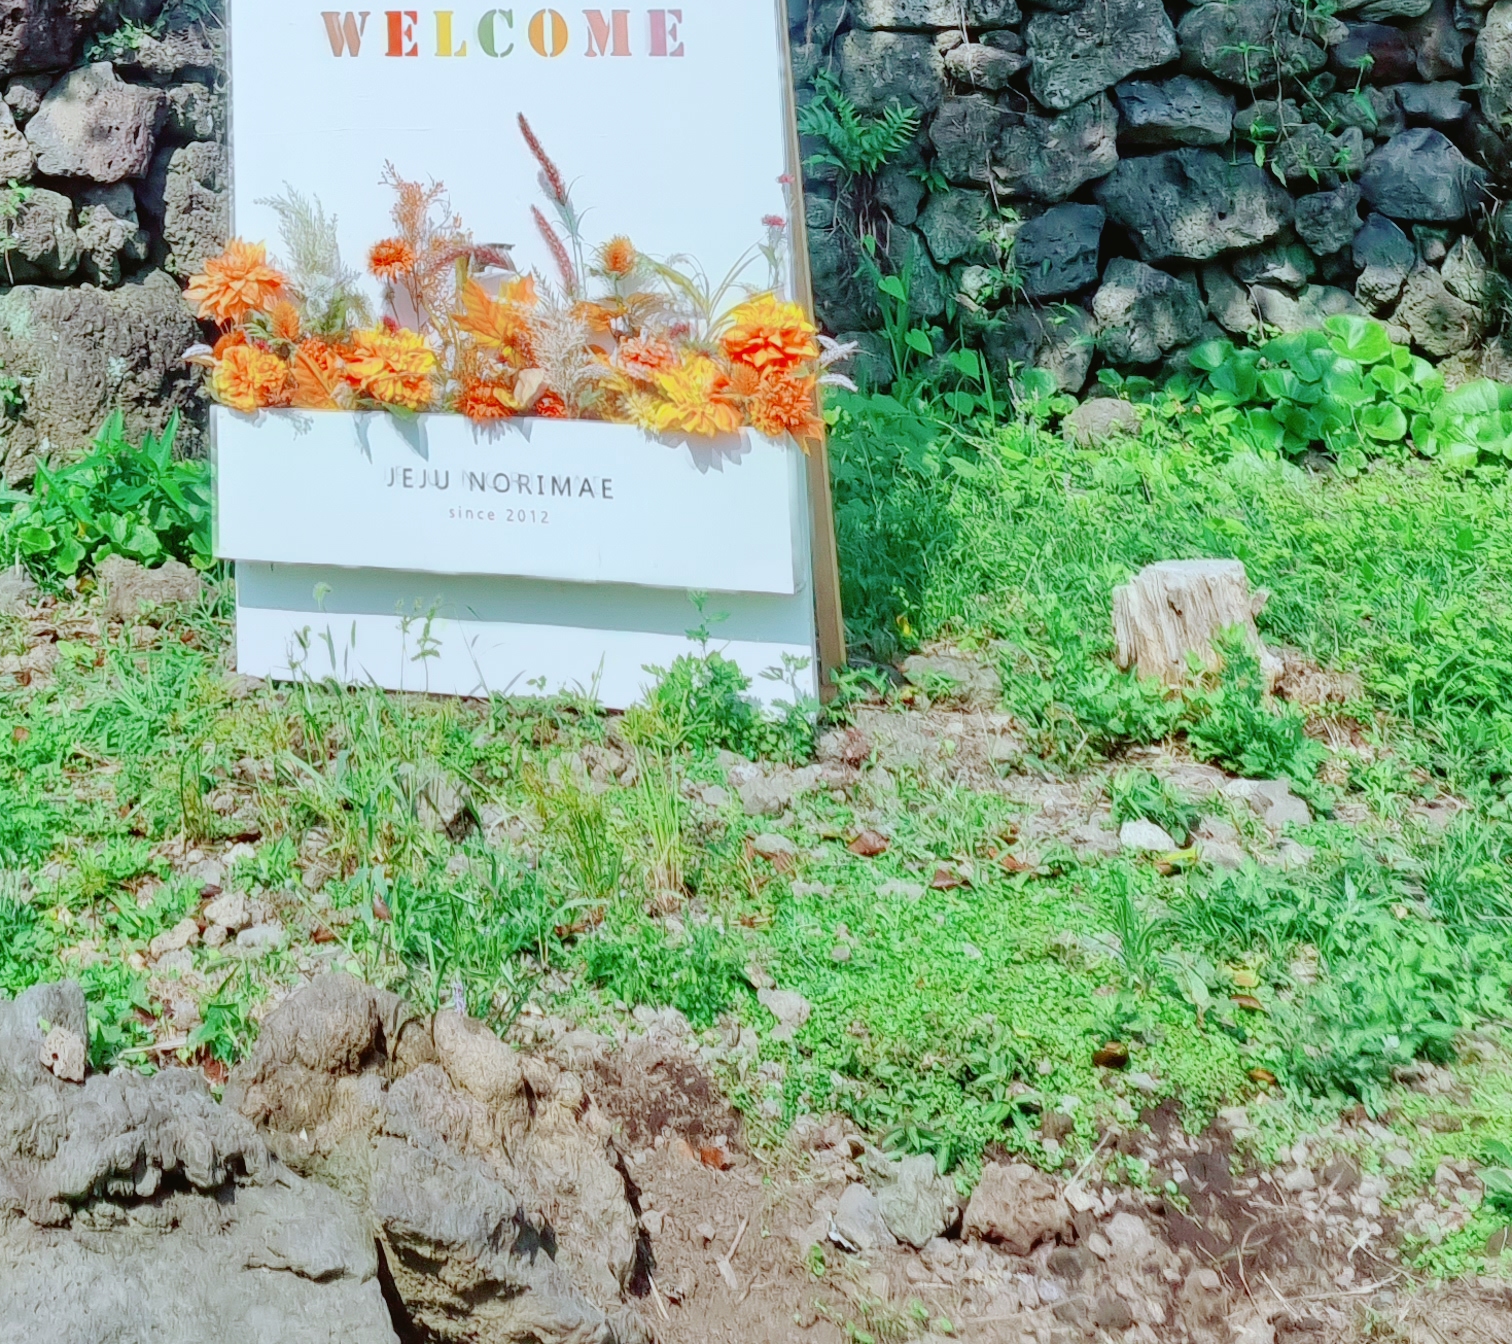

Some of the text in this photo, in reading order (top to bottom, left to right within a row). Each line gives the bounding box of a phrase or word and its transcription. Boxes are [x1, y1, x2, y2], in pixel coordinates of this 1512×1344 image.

[320, 8, 685, 58] WELCOME
[386, 467, 615, 500] JEJU NORIMAE
[448, 505, 550, 525] since 2012
